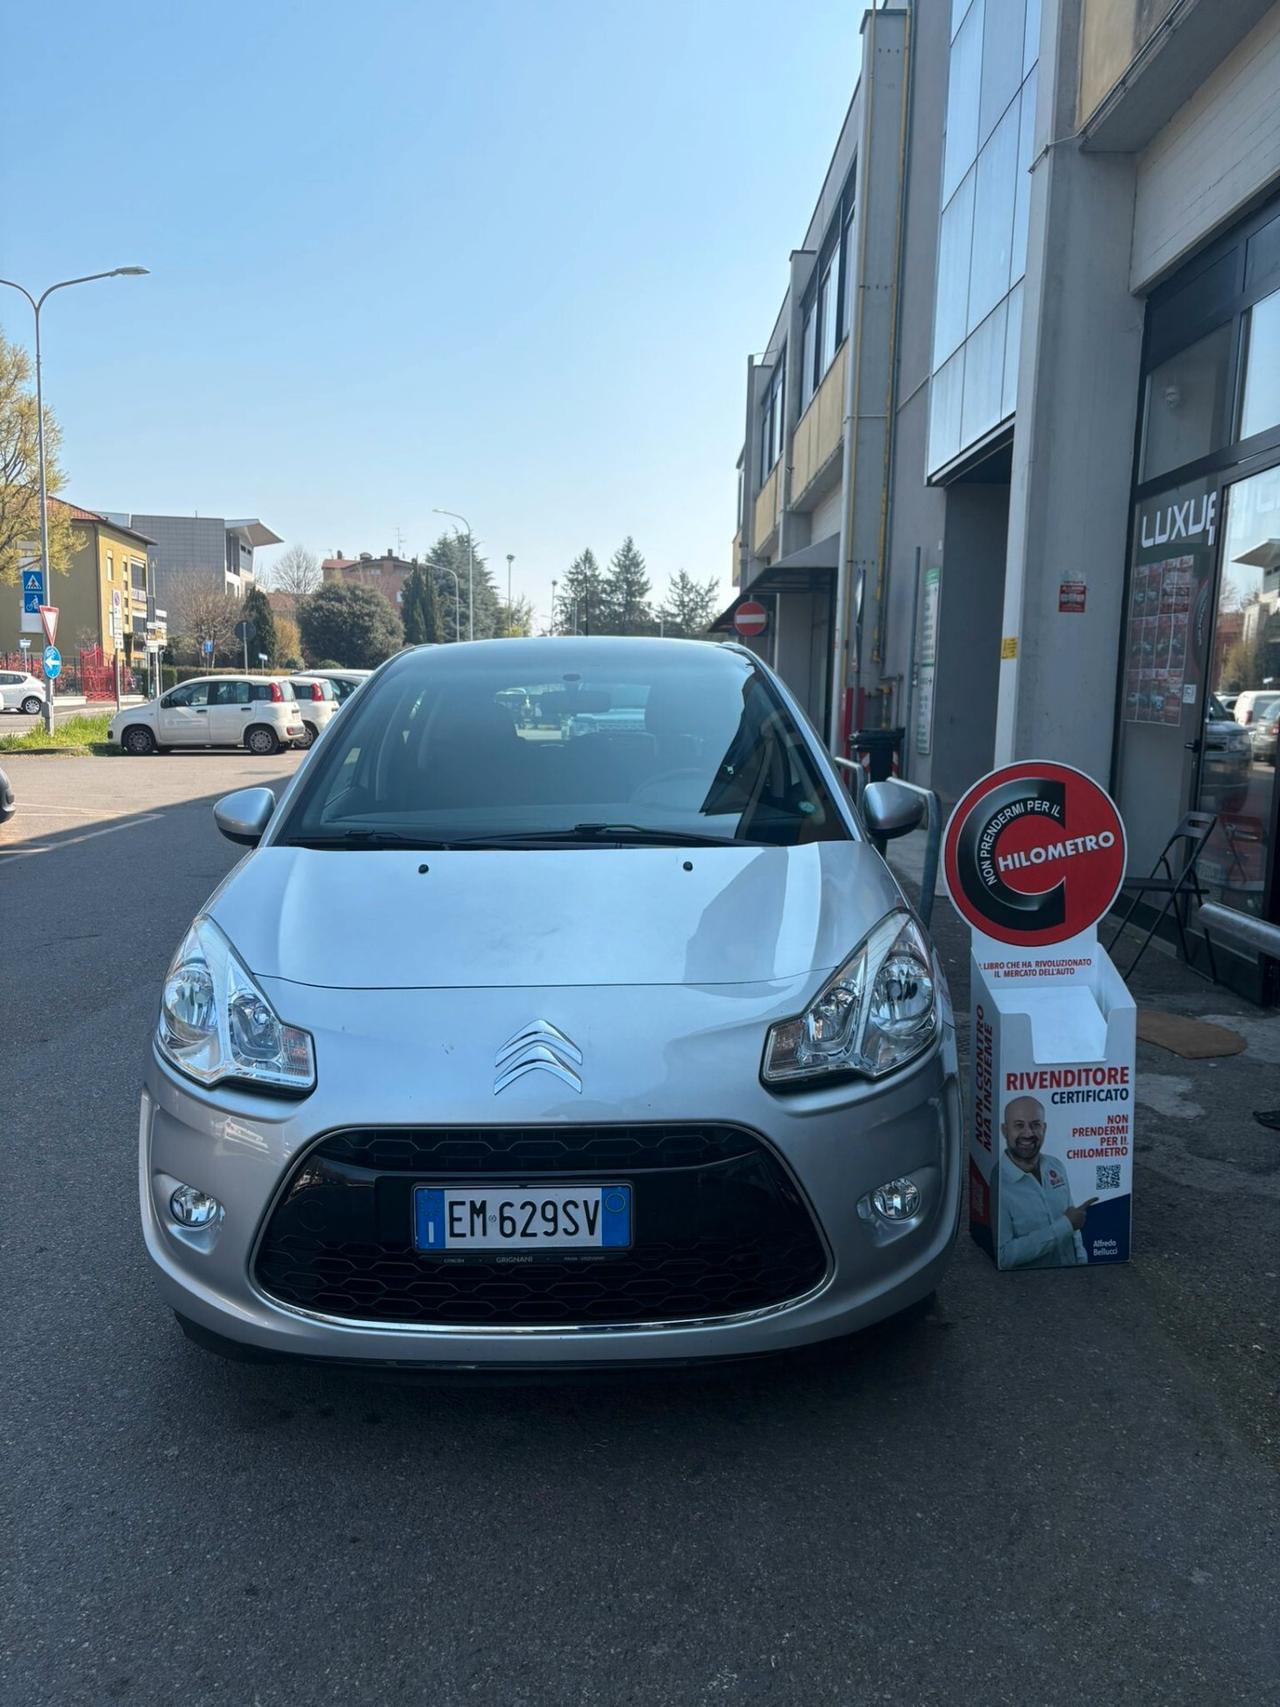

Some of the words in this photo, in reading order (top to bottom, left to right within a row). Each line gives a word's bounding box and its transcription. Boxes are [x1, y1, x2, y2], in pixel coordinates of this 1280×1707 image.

[1027, 800, 1050, 812] PER
[1051, 804, 1061, 817] IL
[980, 802, 1025, 858] PRENDERMI
[980, 860, 998, 886] NON
[983, 961, 1005, 970] LIBRO
[1006, 960, 1021, 969] CHE
[1021, 960, 1032, 968] HA
[1035, 958, 1092, 968] RIVOLUZIONATO
[994, 970, 1001, 978] IL
[1003, 968, 1037, 978] MERCATO
[1038, 967, 1075, 977] DELL'AUTO
[975, 1004, 984, 1091] CONTRO
[983, 1021, 993, 1114] INSIEME
[1006, 1067, 1130, 1091] RIVENDITORE
[1051, 1088, 1129, 1104] CERTIFICATO
[975, 1099, 984, 1145] NON
[1107, 1114, 1129, 1124] NON
[983, 1119, 992, 1153] MA
[1072, 1125, 1128, 1137] PRENDERMI
[1100, 1136, 1118, 1146] PER
[1066, 1146, 1128, 1160] CHILOMETRO
[1093, 1239, 1117, 1248] Alfredo
[1093, 1248, 1118, 1257] Bellucci
